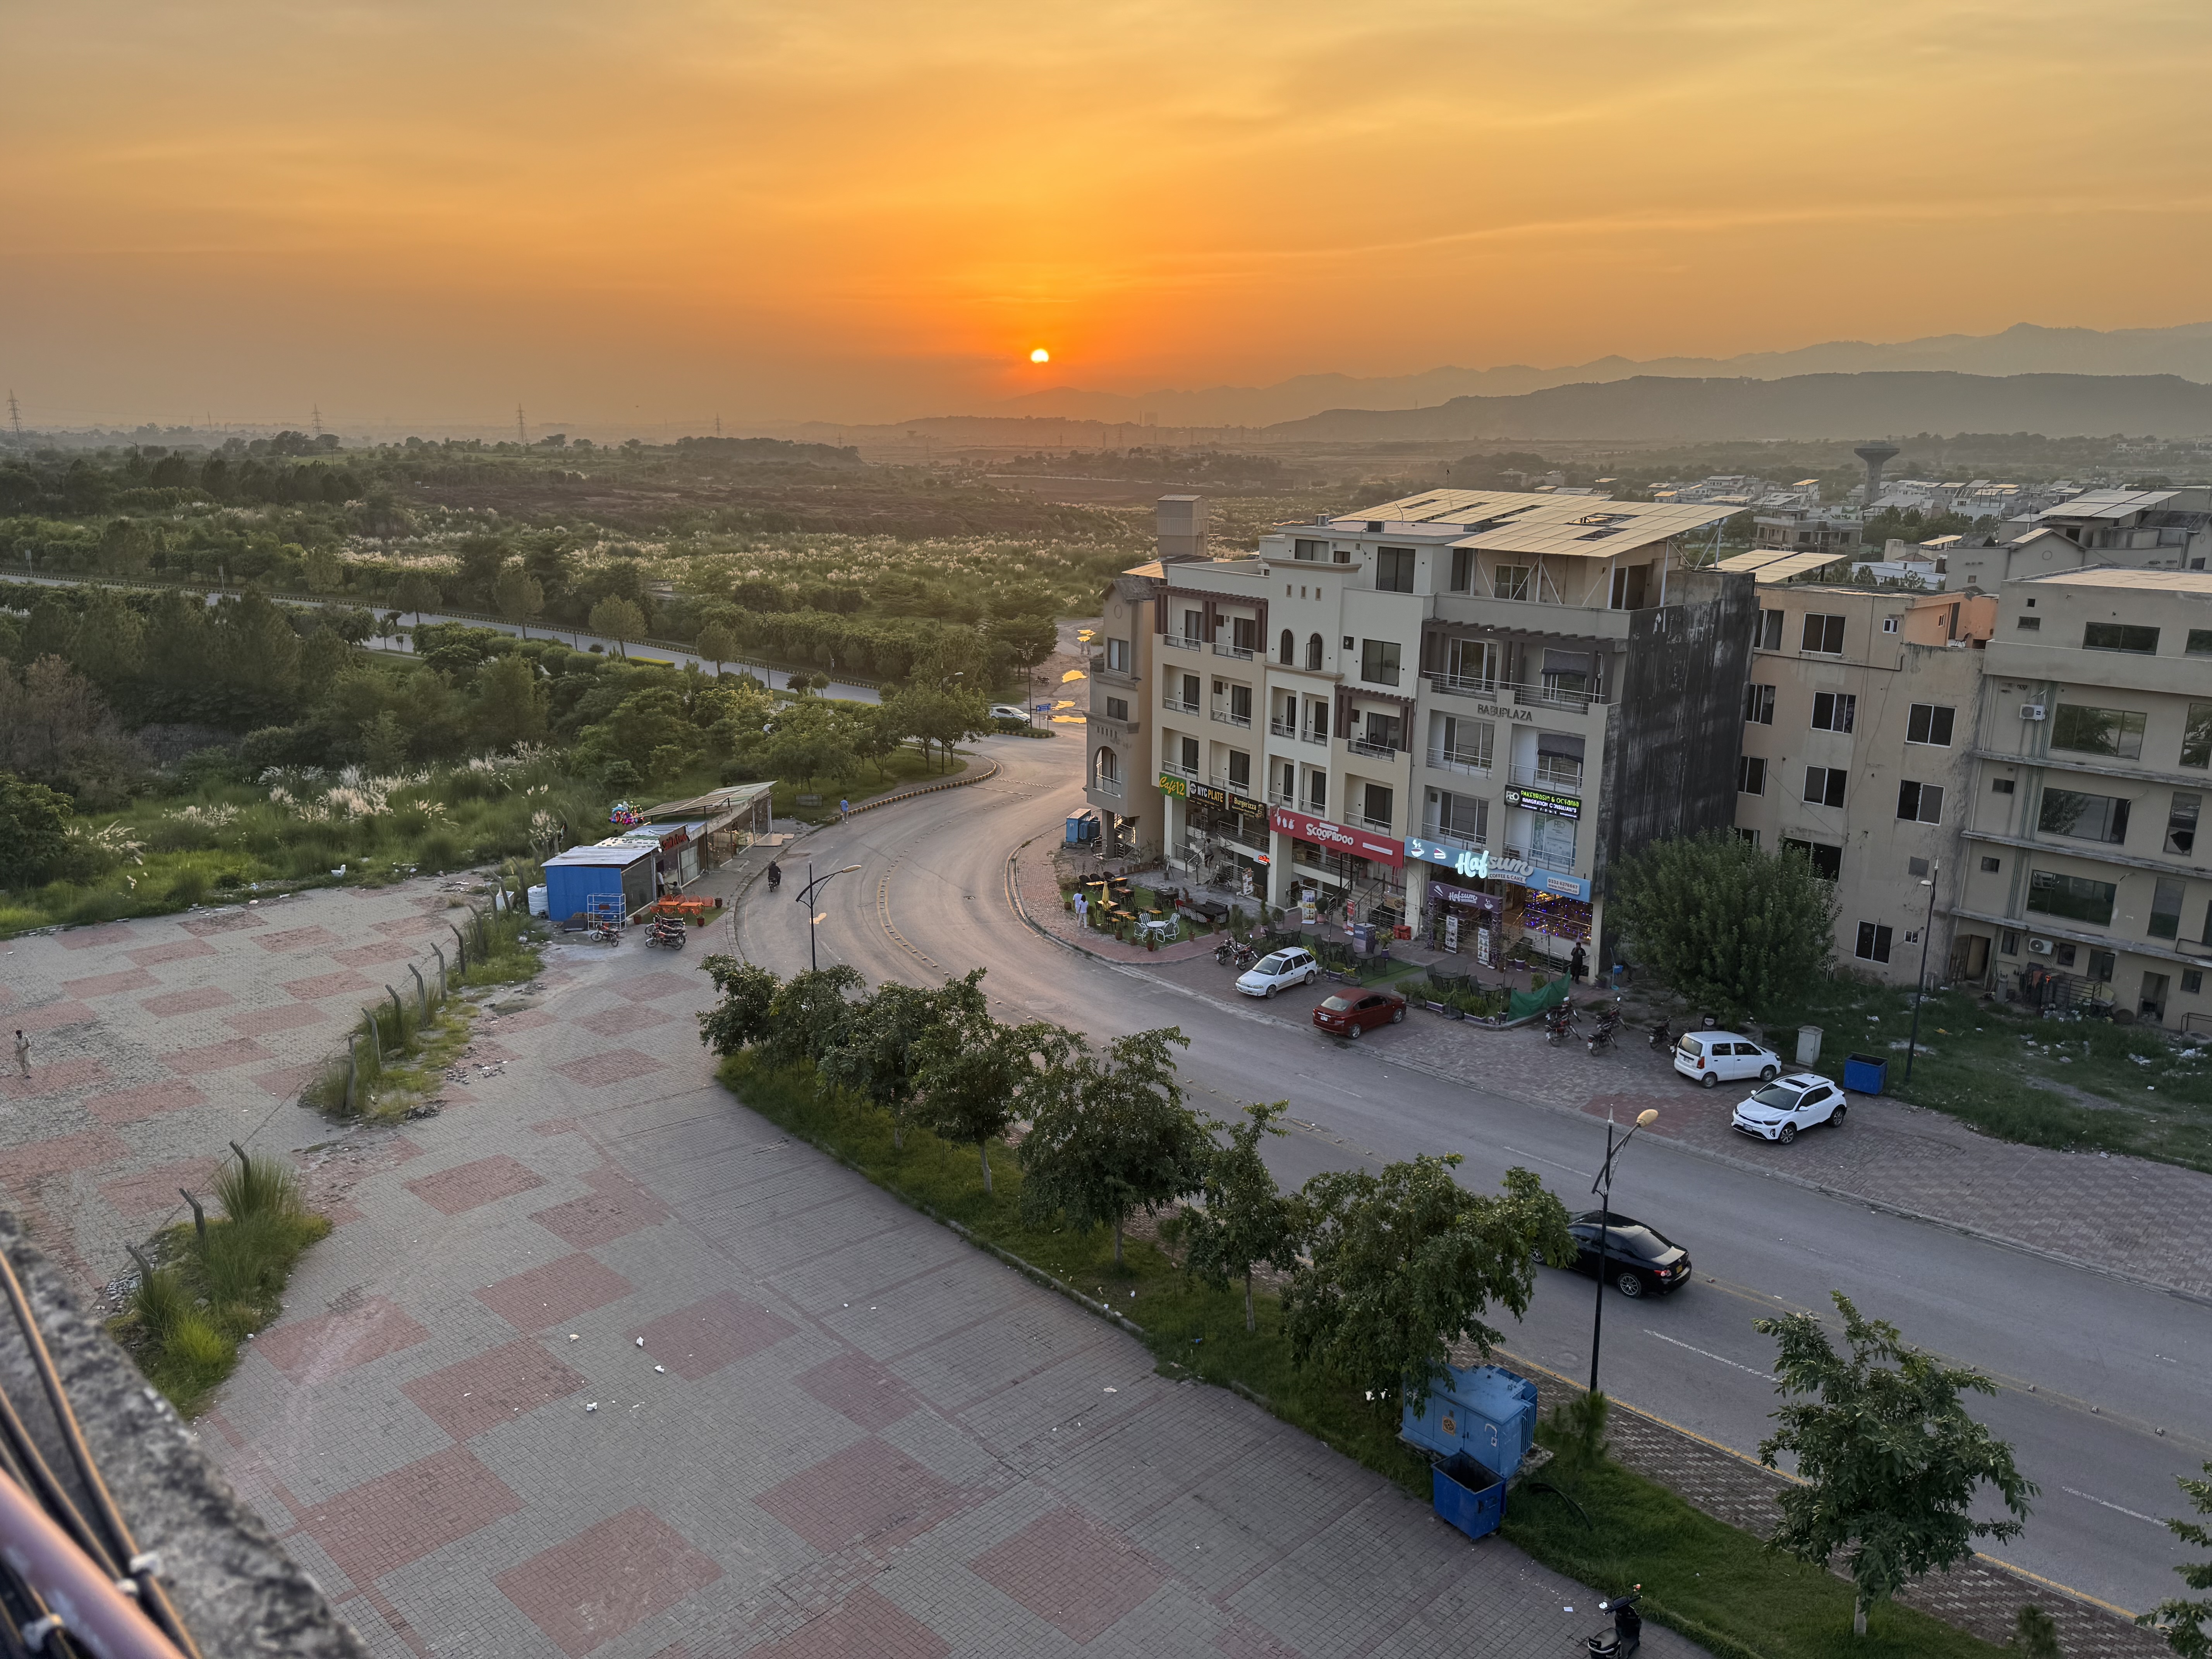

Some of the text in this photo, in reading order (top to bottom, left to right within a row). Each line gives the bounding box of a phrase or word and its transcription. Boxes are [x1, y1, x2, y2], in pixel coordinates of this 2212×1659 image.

[1198, 786, 1207, 797] NYC
[1208, 789, 1223, 802] PLATE
[1234, 797, 1256, 810] Burgerizza
[1306, 823, 1354, 845] SCOOPADOO
[1455, 850, 1534, 879] Hafsum
[1448, 891, 1478, 902] Hafsum
